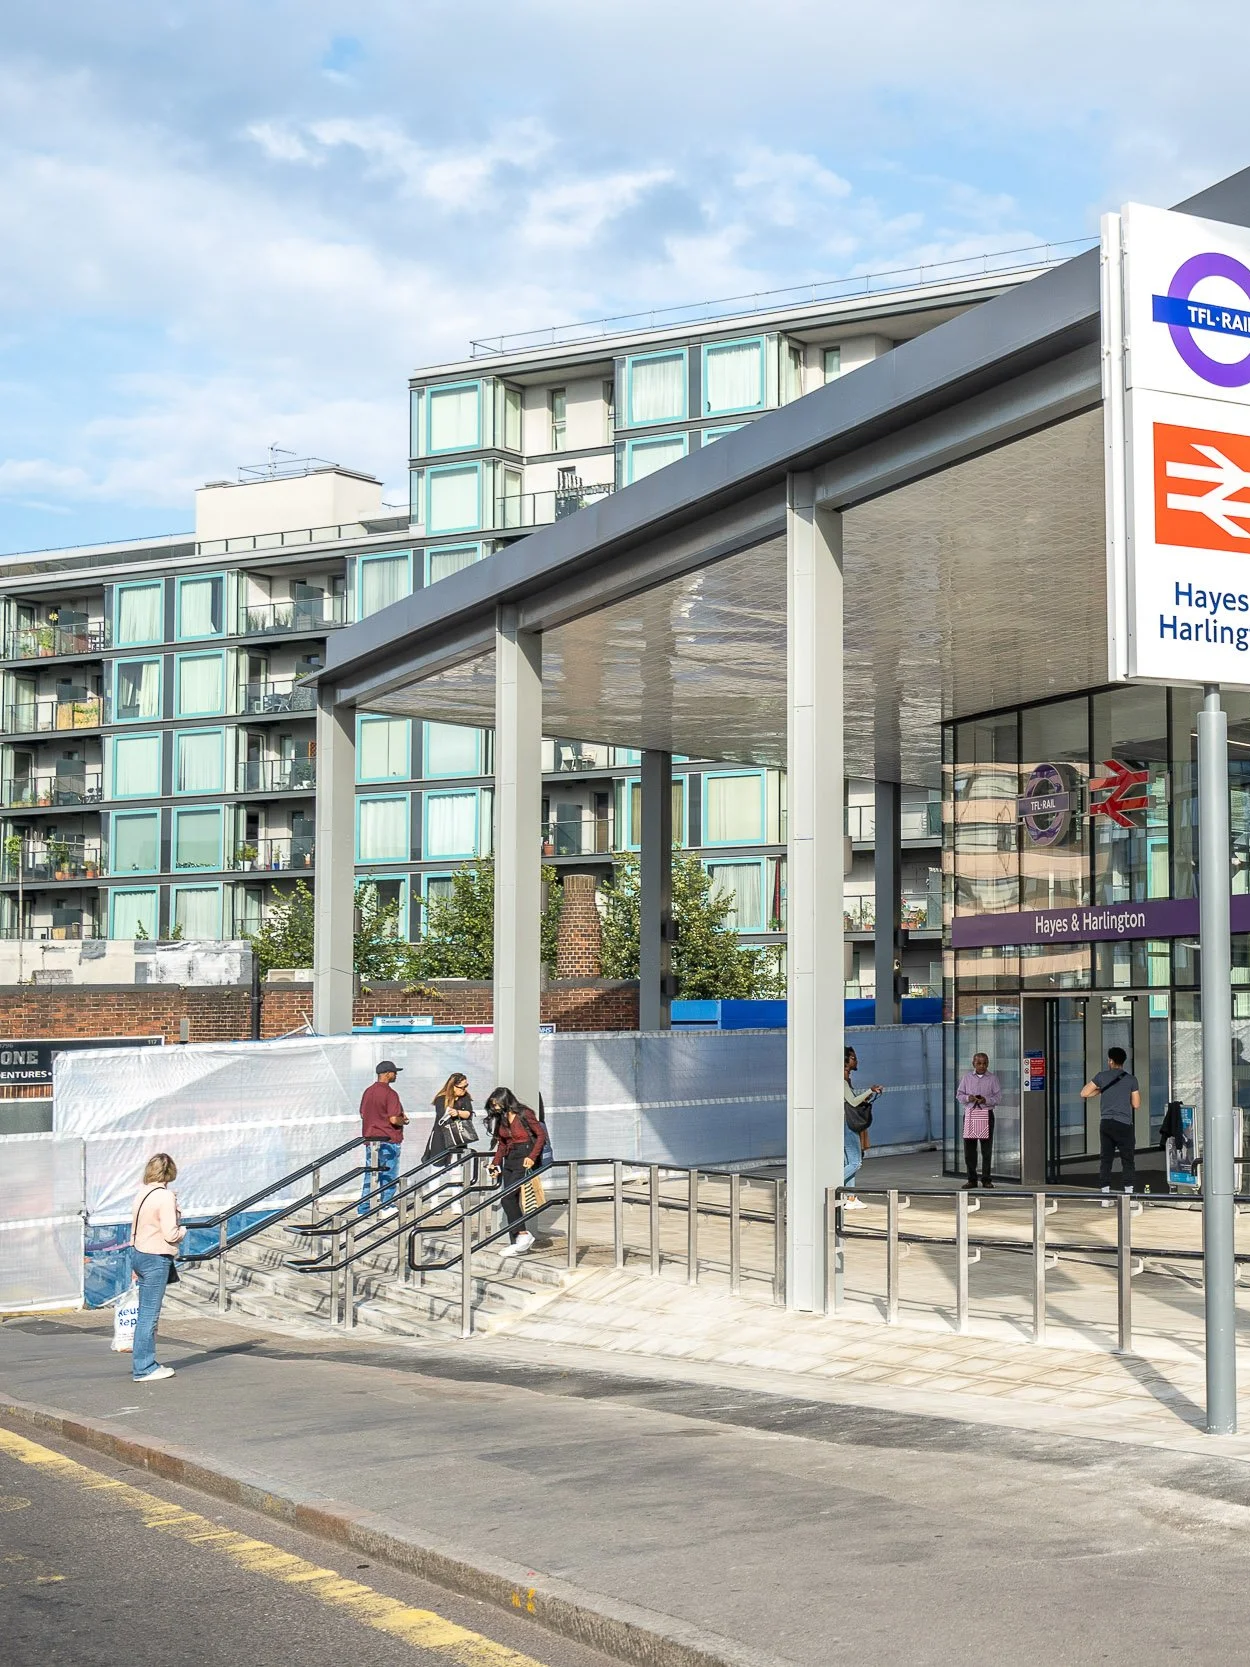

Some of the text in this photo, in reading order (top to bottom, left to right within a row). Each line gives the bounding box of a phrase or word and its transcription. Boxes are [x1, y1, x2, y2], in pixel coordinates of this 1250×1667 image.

[1175, 581, 1249, 615] Hayes
[1035, 911, 1145, 937] Hayes & Harlington
[0, 1070, 48, 1079] ENTURES
